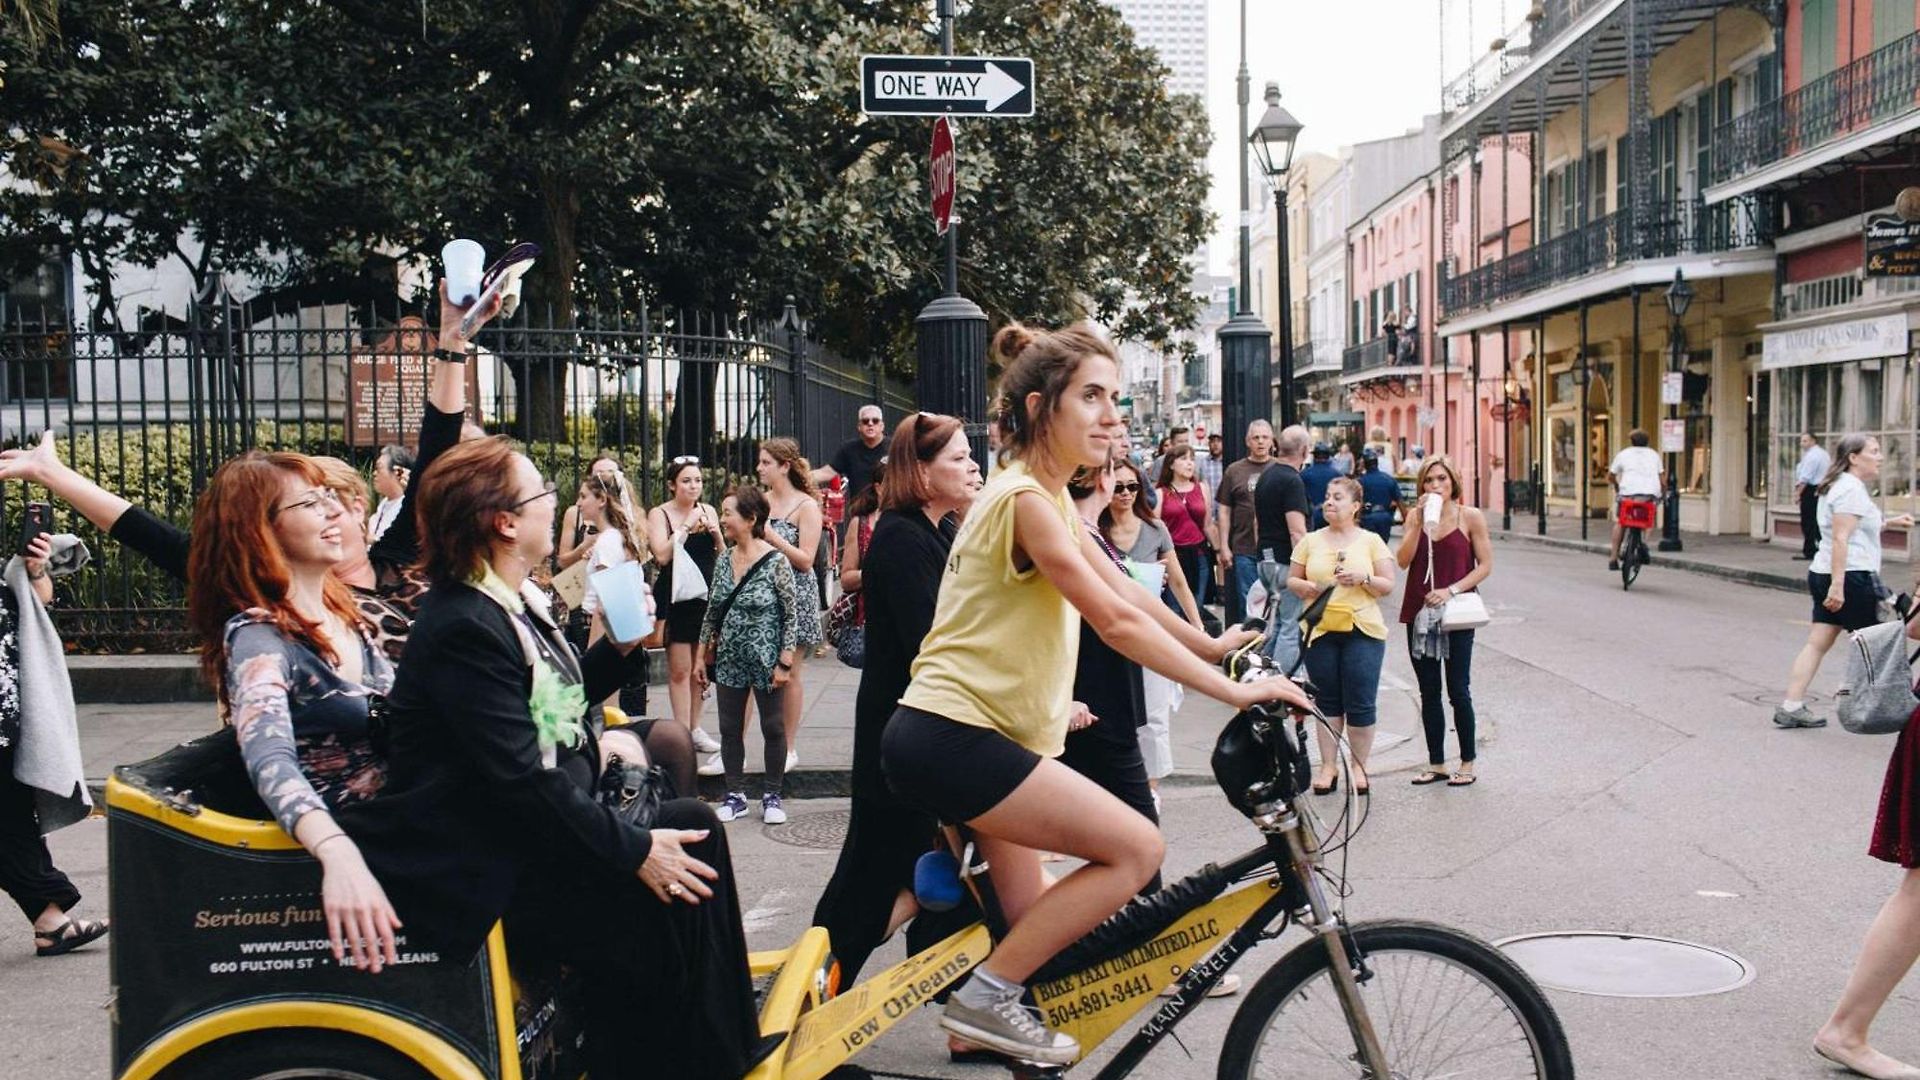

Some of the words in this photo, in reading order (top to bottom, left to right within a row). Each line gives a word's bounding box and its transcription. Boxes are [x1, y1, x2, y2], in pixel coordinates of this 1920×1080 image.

[882, 75, 926, 96] ONE
[936, 76, 981, 97] WAY
[932, 150, 952, 202] STOP
[194, 908, 280, 928] Serious
[281, 905, 323, 927] fun
[209, 962, 238, 973] 600
[240, 959, 295, 972] FULTON
[297, 958, 315, 969] ST
[883, 952, 970, 1019] Orleans
[1039, 975, 1075, 1002] BIKE
[1078, 961, 1111, 988] TAXI
[1048, 973, 1154, 1028] 504-891-3441
[516, 997, 556, 1053] FULTON
